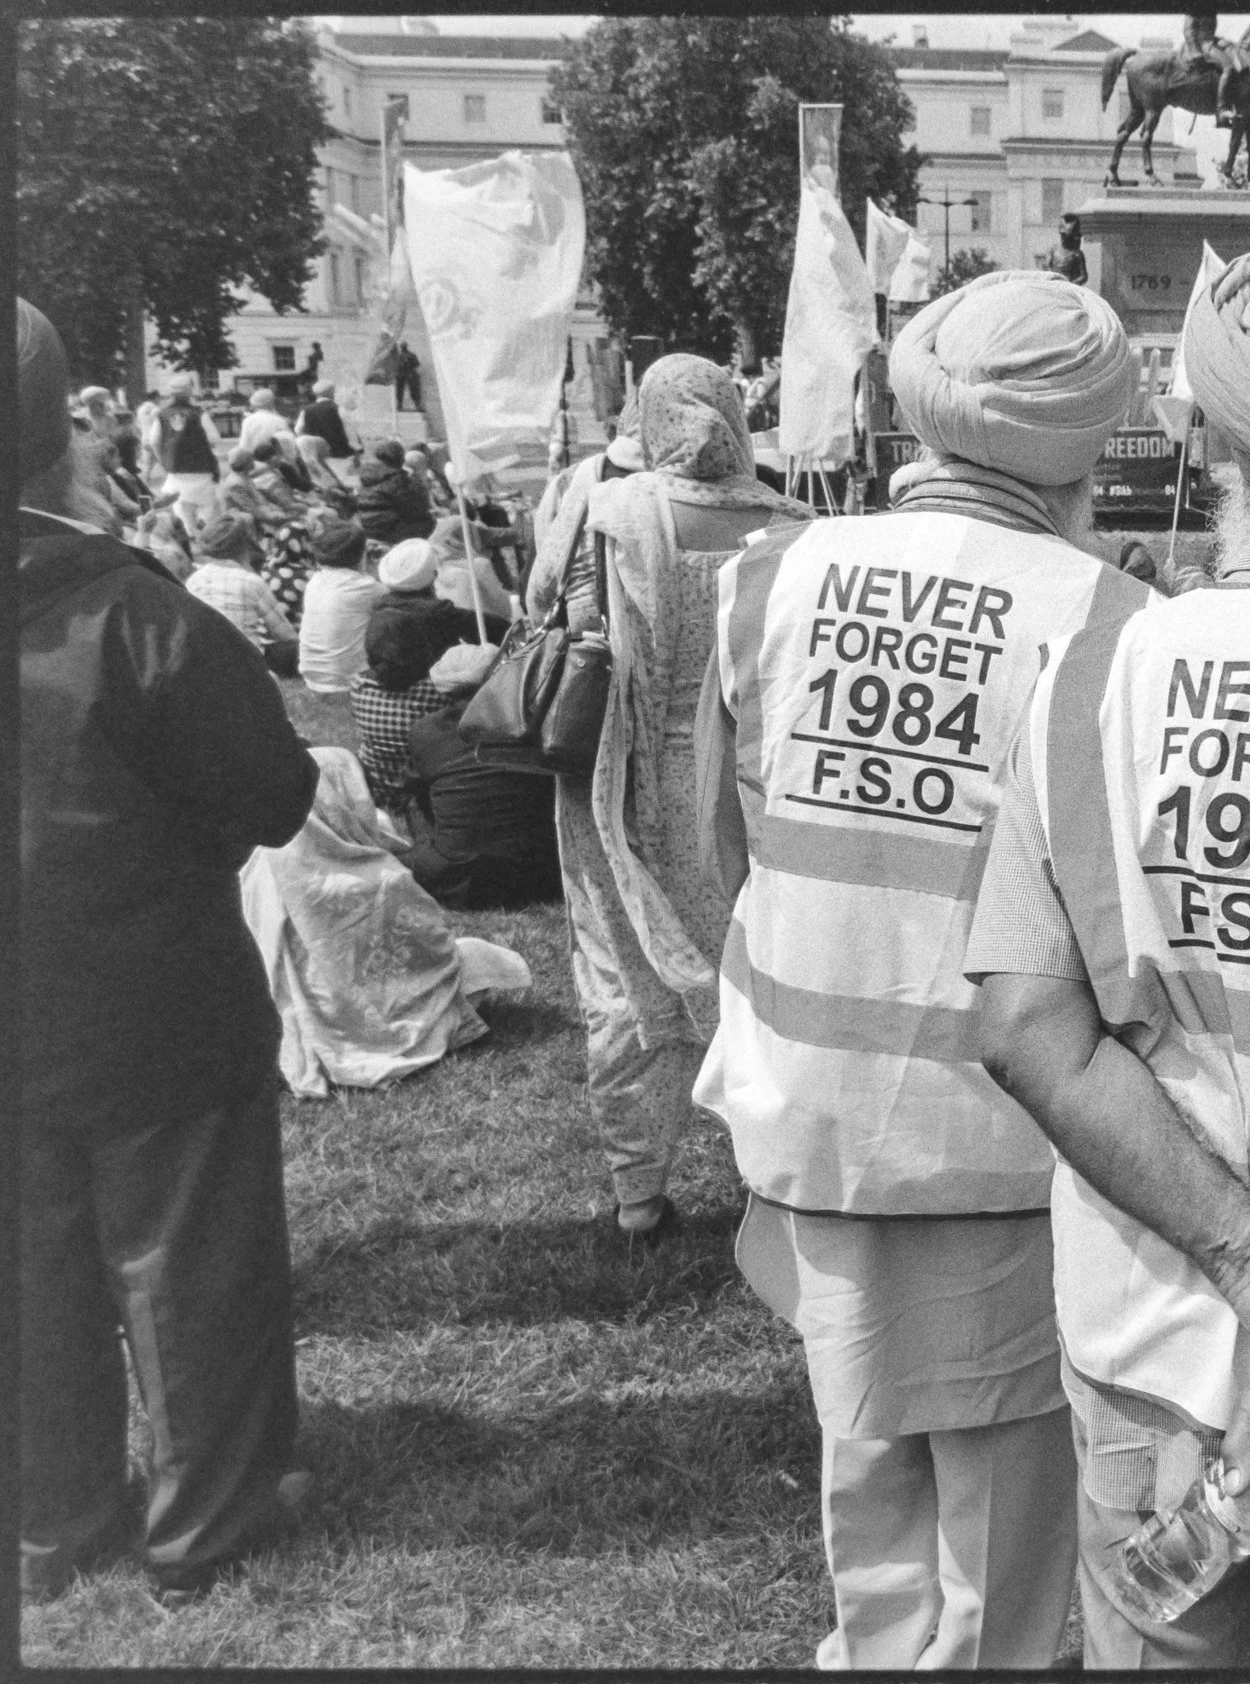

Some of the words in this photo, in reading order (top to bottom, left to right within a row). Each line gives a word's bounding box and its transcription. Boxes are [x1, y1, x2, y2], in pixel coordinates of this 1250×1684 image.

[1104, 436, 1175, 459] REEDOM
[816, 562, 1014, 640] NEVER
[808, 617, 1004, 686] FORGET
[808, 668, 981, 756] 1984
[811, 748, 955, 816] F.S.O
